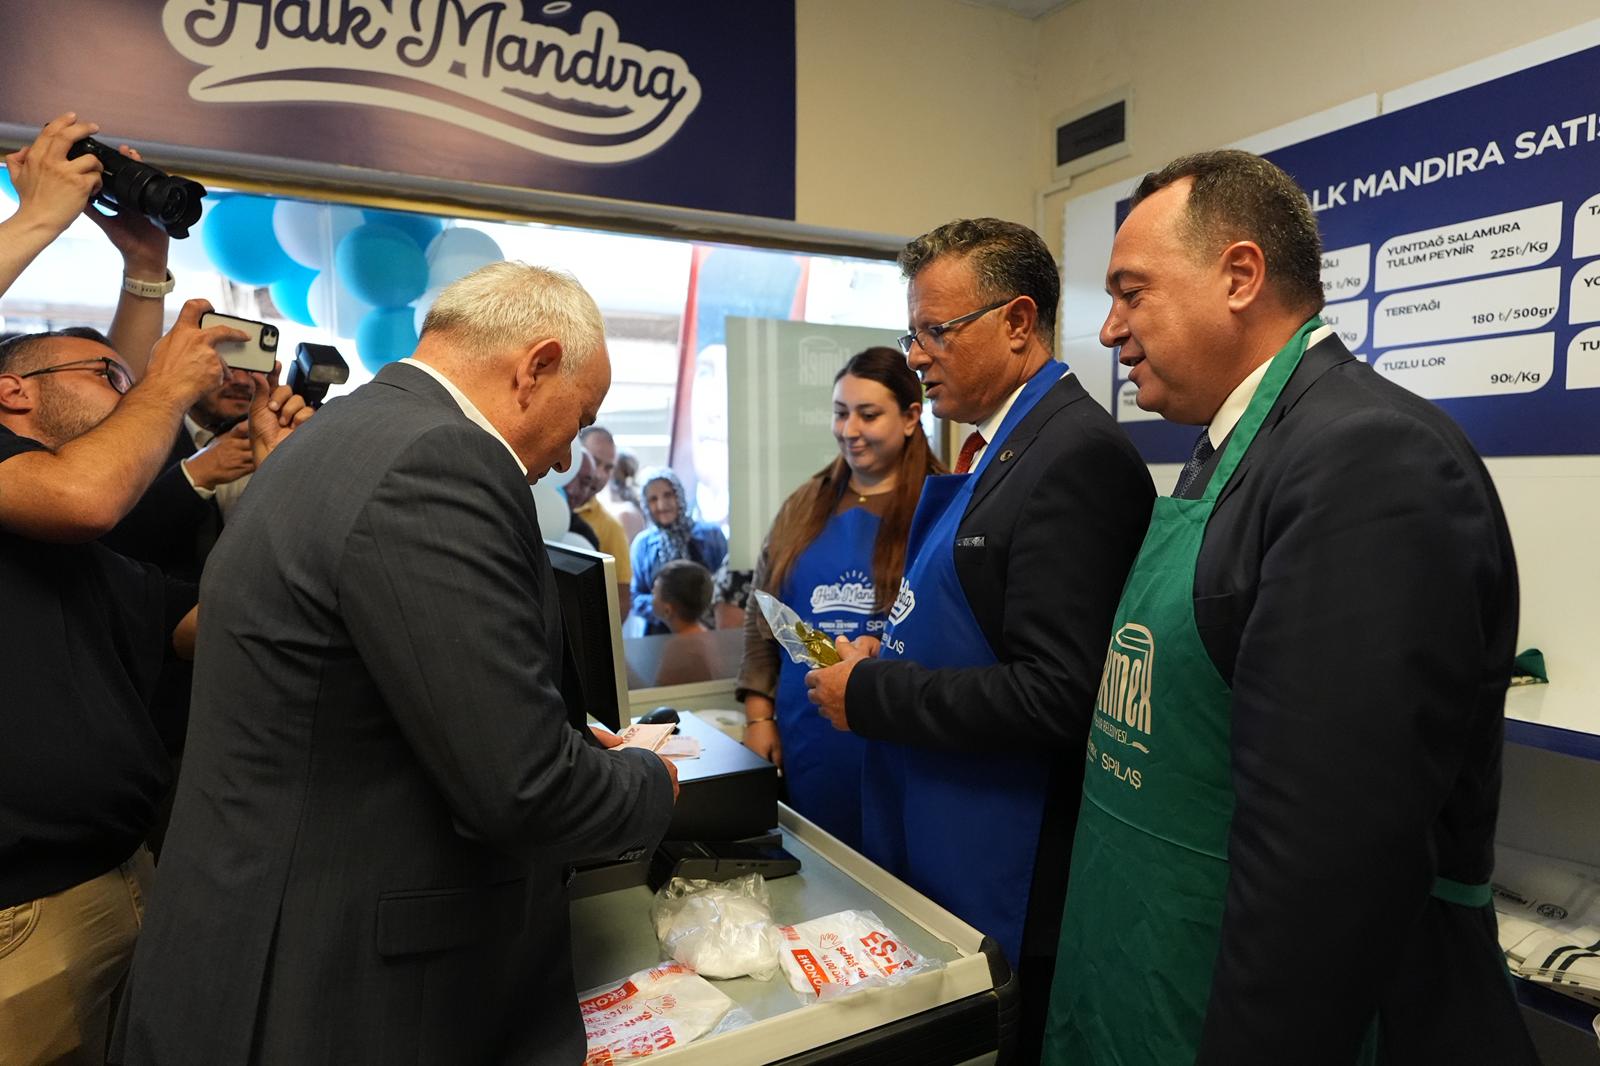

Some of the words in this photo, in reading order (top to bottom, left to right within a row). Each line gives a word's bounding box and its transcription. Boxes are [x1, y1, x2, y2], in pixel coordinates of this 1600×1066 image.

[1311, 182, 1347, 212] LK
[1353, 141, 1505, 201] MANDIRA
[1513, 113, 1600, 160] SATI
[1387, 236, 1445, 256] YUNTDAĞ
[1447, 222, 1521, 245] SALAMURA
[1386, 254, 1427, 269] TULUM
[1429, 244, 1475, 261] PEYNİR
[1385, 300, 1441, 317] TEREYAĞI
[1383, 359, 1419, 371] TUZLU
[1421, 356, 1446, 368] LOR
[797, 953, 824, 990] EKONO
